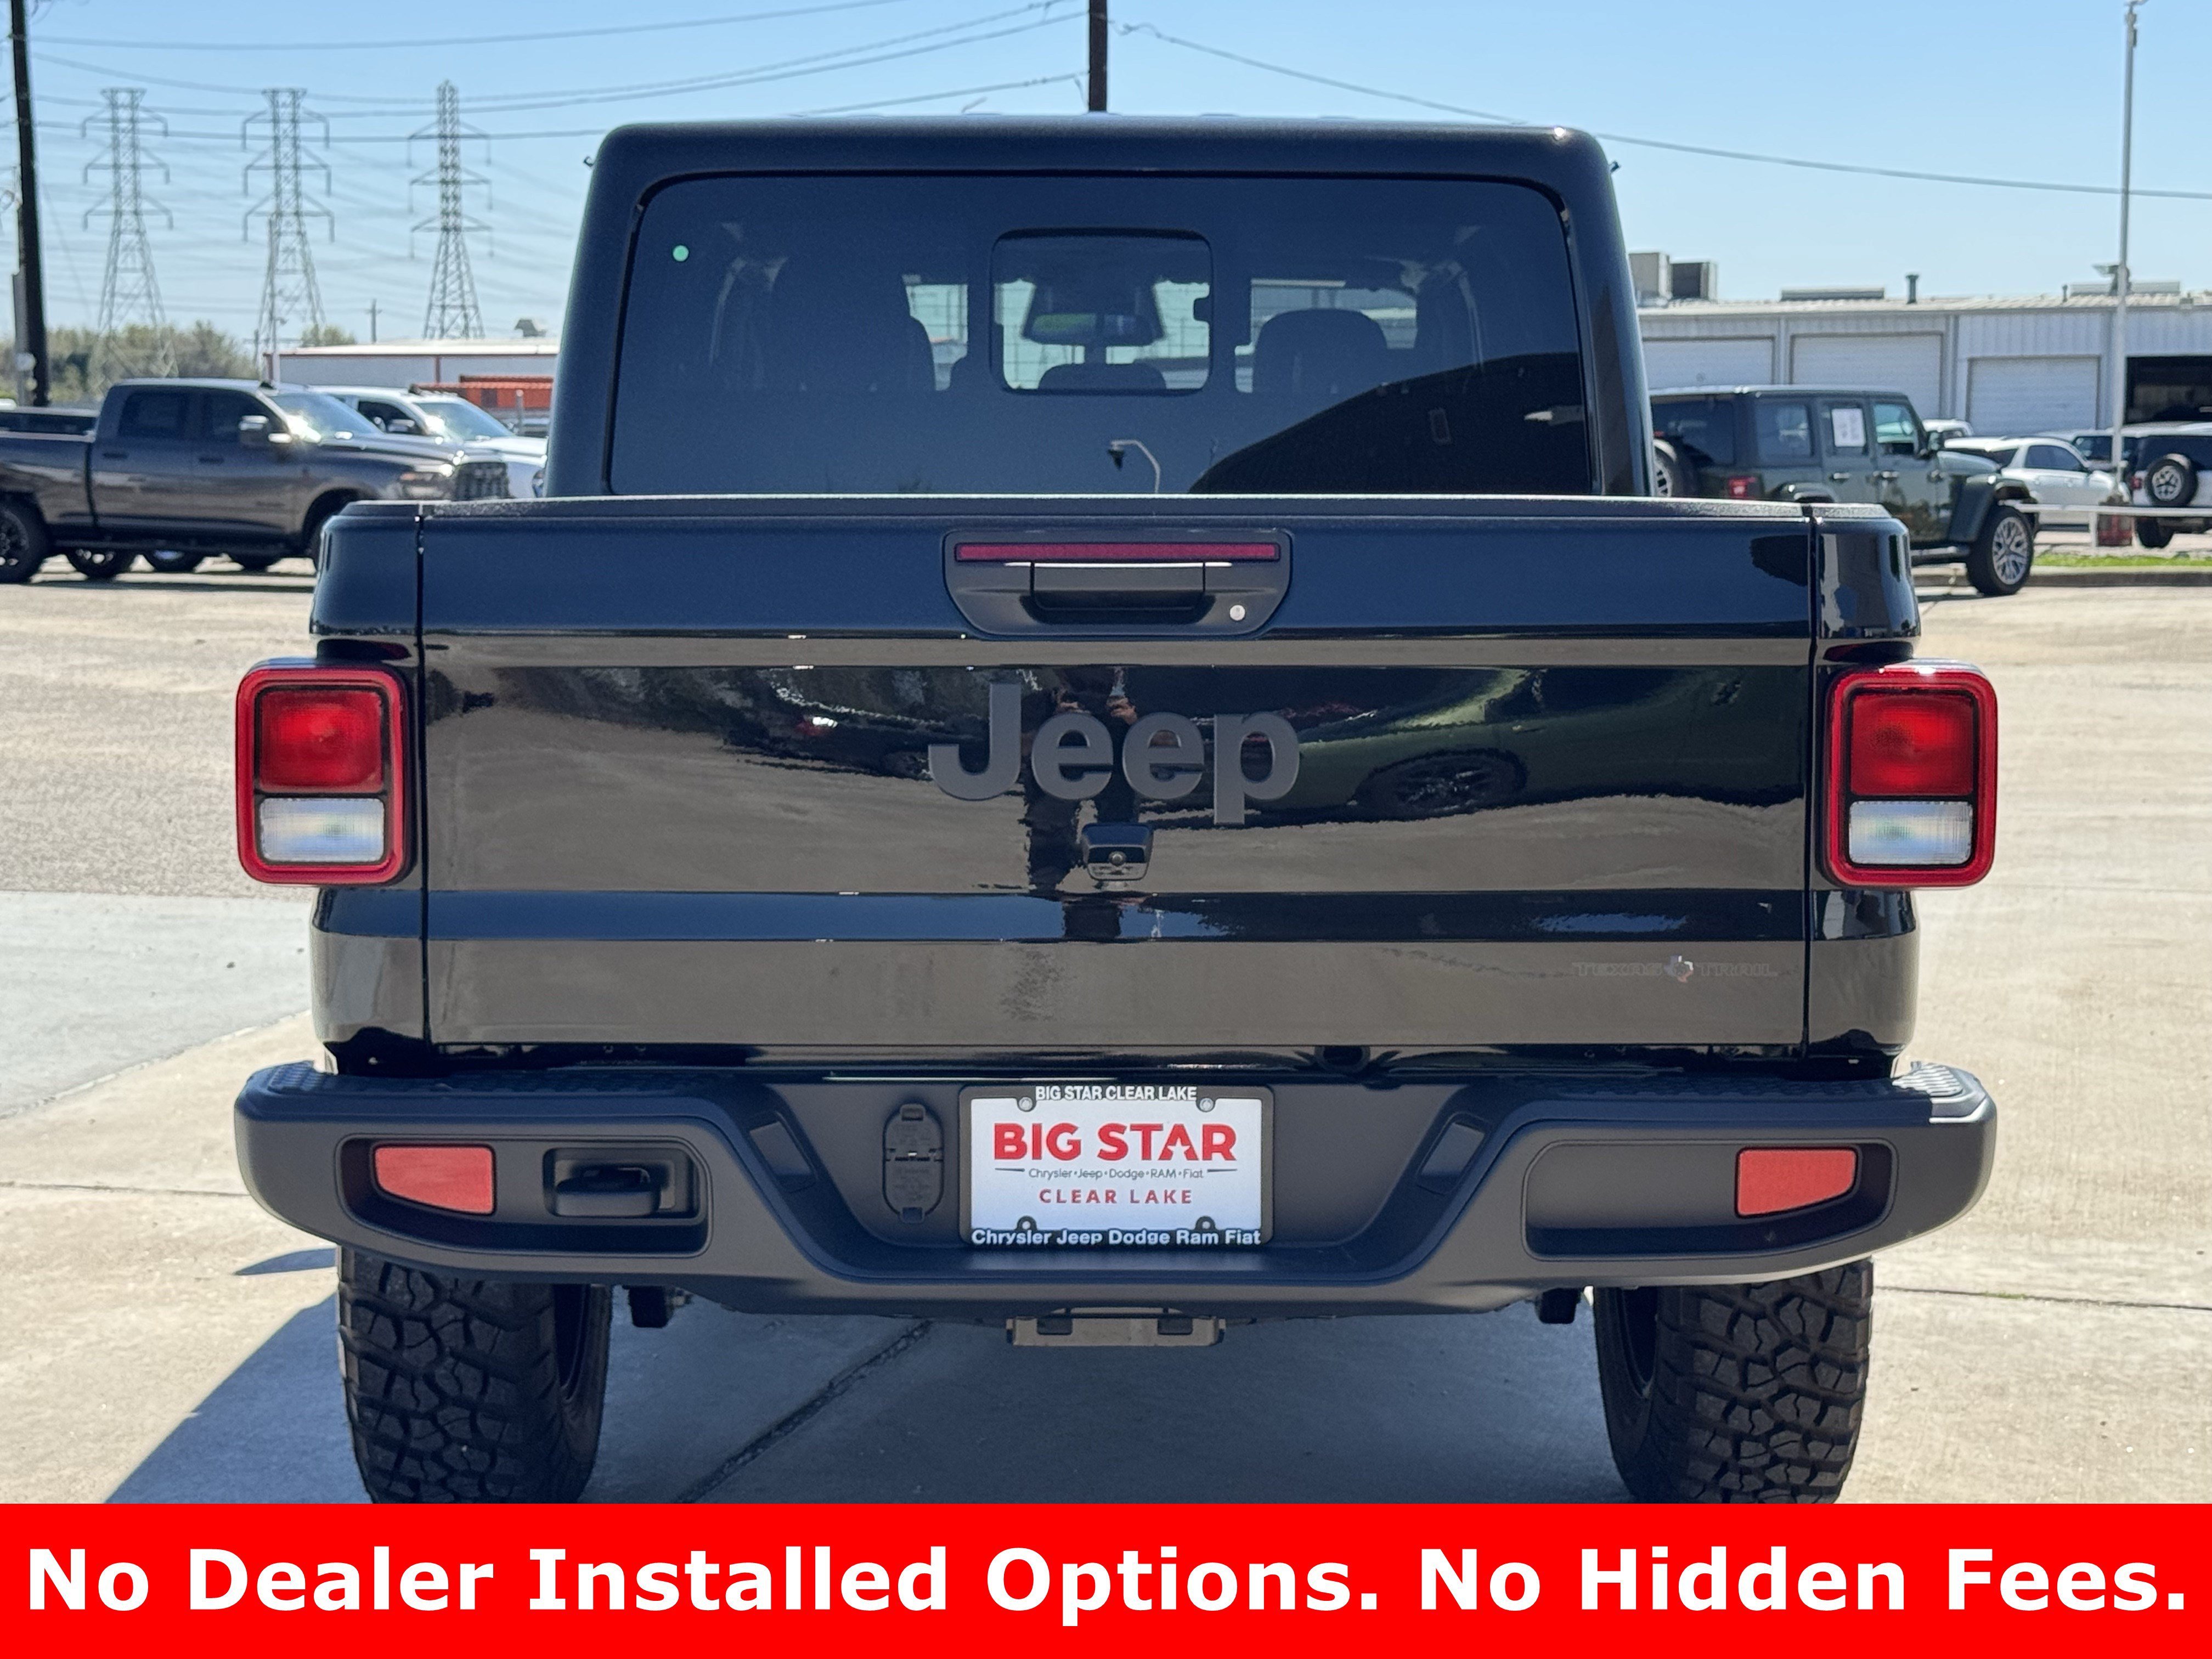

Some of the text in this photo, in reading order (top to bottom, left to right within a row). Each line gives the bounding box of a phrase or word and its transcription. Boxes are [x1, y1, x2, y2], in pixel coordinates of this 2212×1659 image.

[928, 683, 1300, 824] Jeep
[1572, 962, 1779, 977] TEXAS TRAIL
[1035, 1085, 1198, 1101] BIG STAR CLEAR LAKE
[994, 1122, 1237, 1161] BIG STAR
[1028, 1168, 1204, 1180] Chrysler Jeep Dodge RAM Fiat
[1039, 1188, 1192, 1204] CLEAR LAKE
[972, 1229, 1261, 1245] Chrysler Jeep Dodge Ram Fiat
